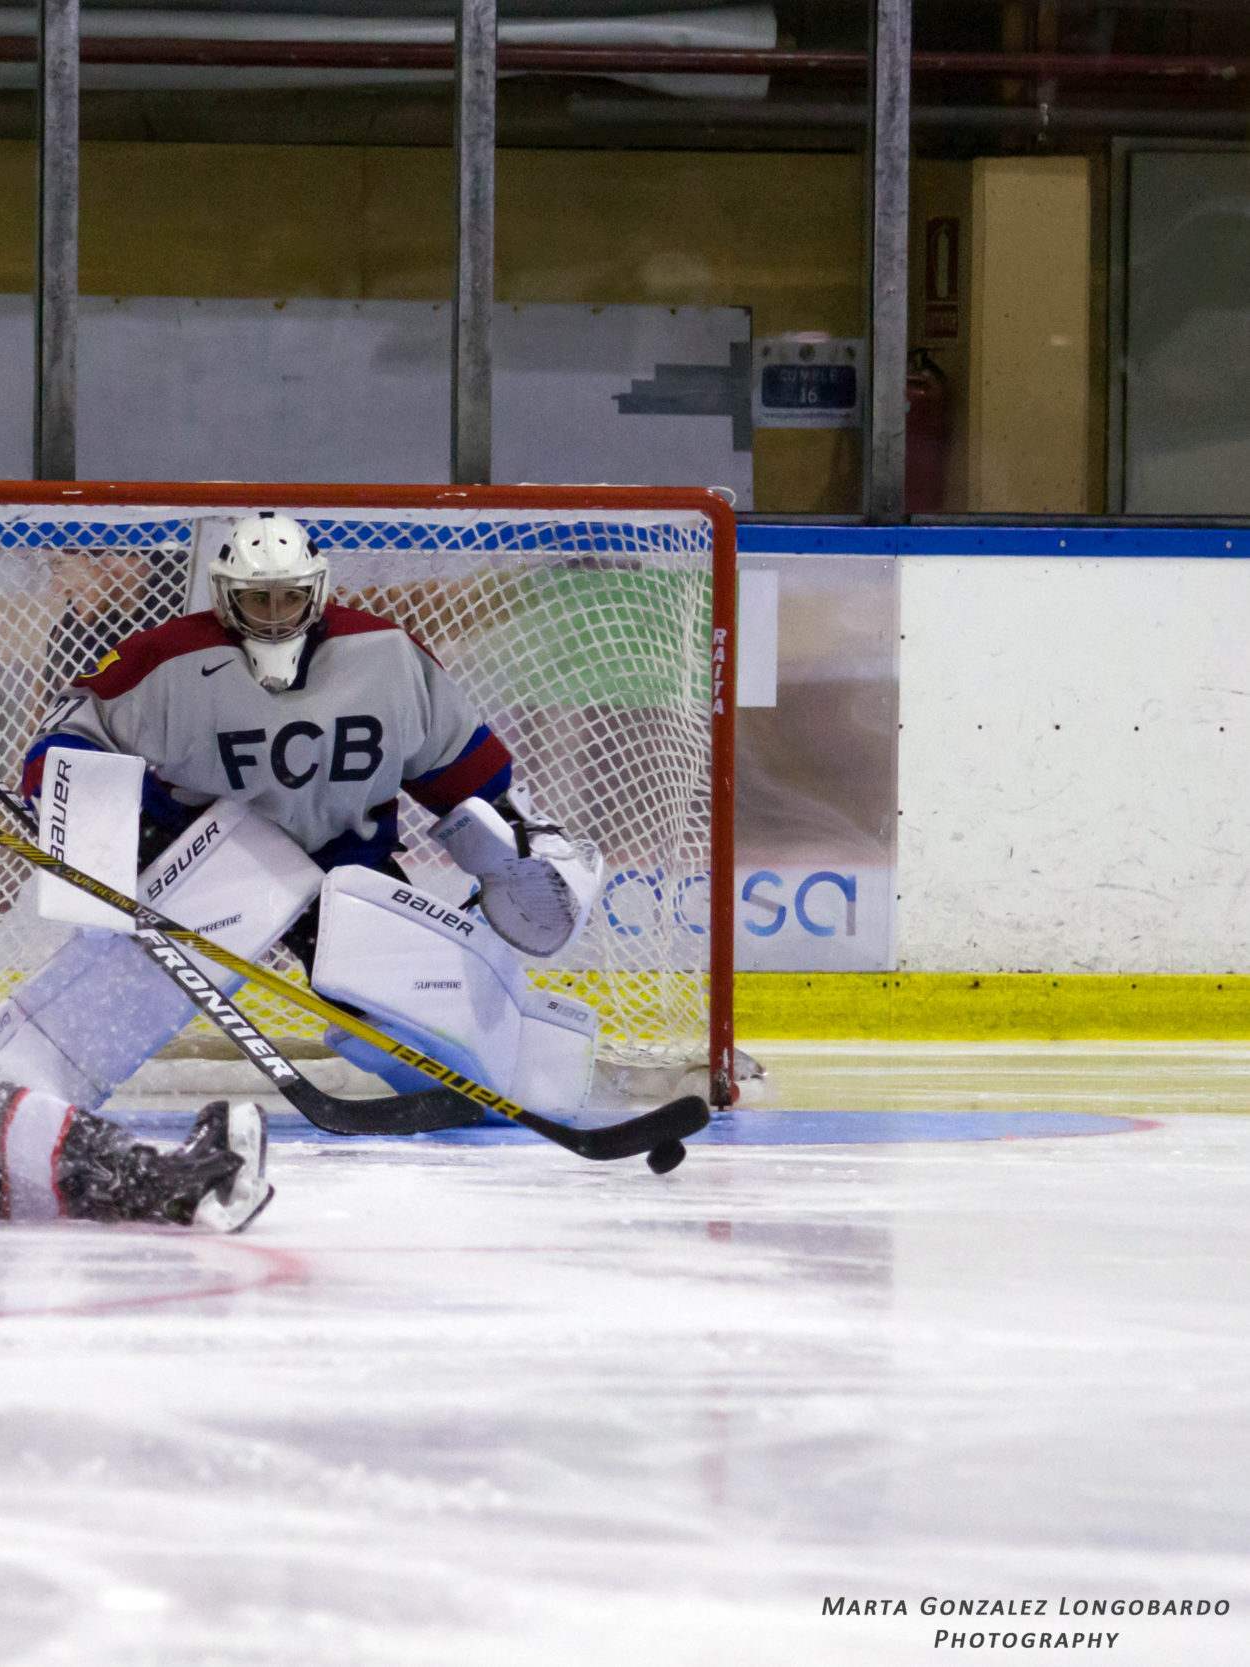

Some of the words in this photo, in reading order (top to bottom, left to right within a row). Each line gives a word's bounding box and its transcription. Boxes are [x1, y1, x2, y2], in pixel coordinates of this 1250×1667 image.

[712, 628, 728, 715] RAITA
[217, 714, 384, 790] FCB
[146, 820, 222, 903] BAUER
[391, 888, 475, 937] BAUER
[135, 928, 301, 1081] FRONTIER
[414, 980, 462, 991] SUPREME
[391, 1043, 524, 1121] BAUER
